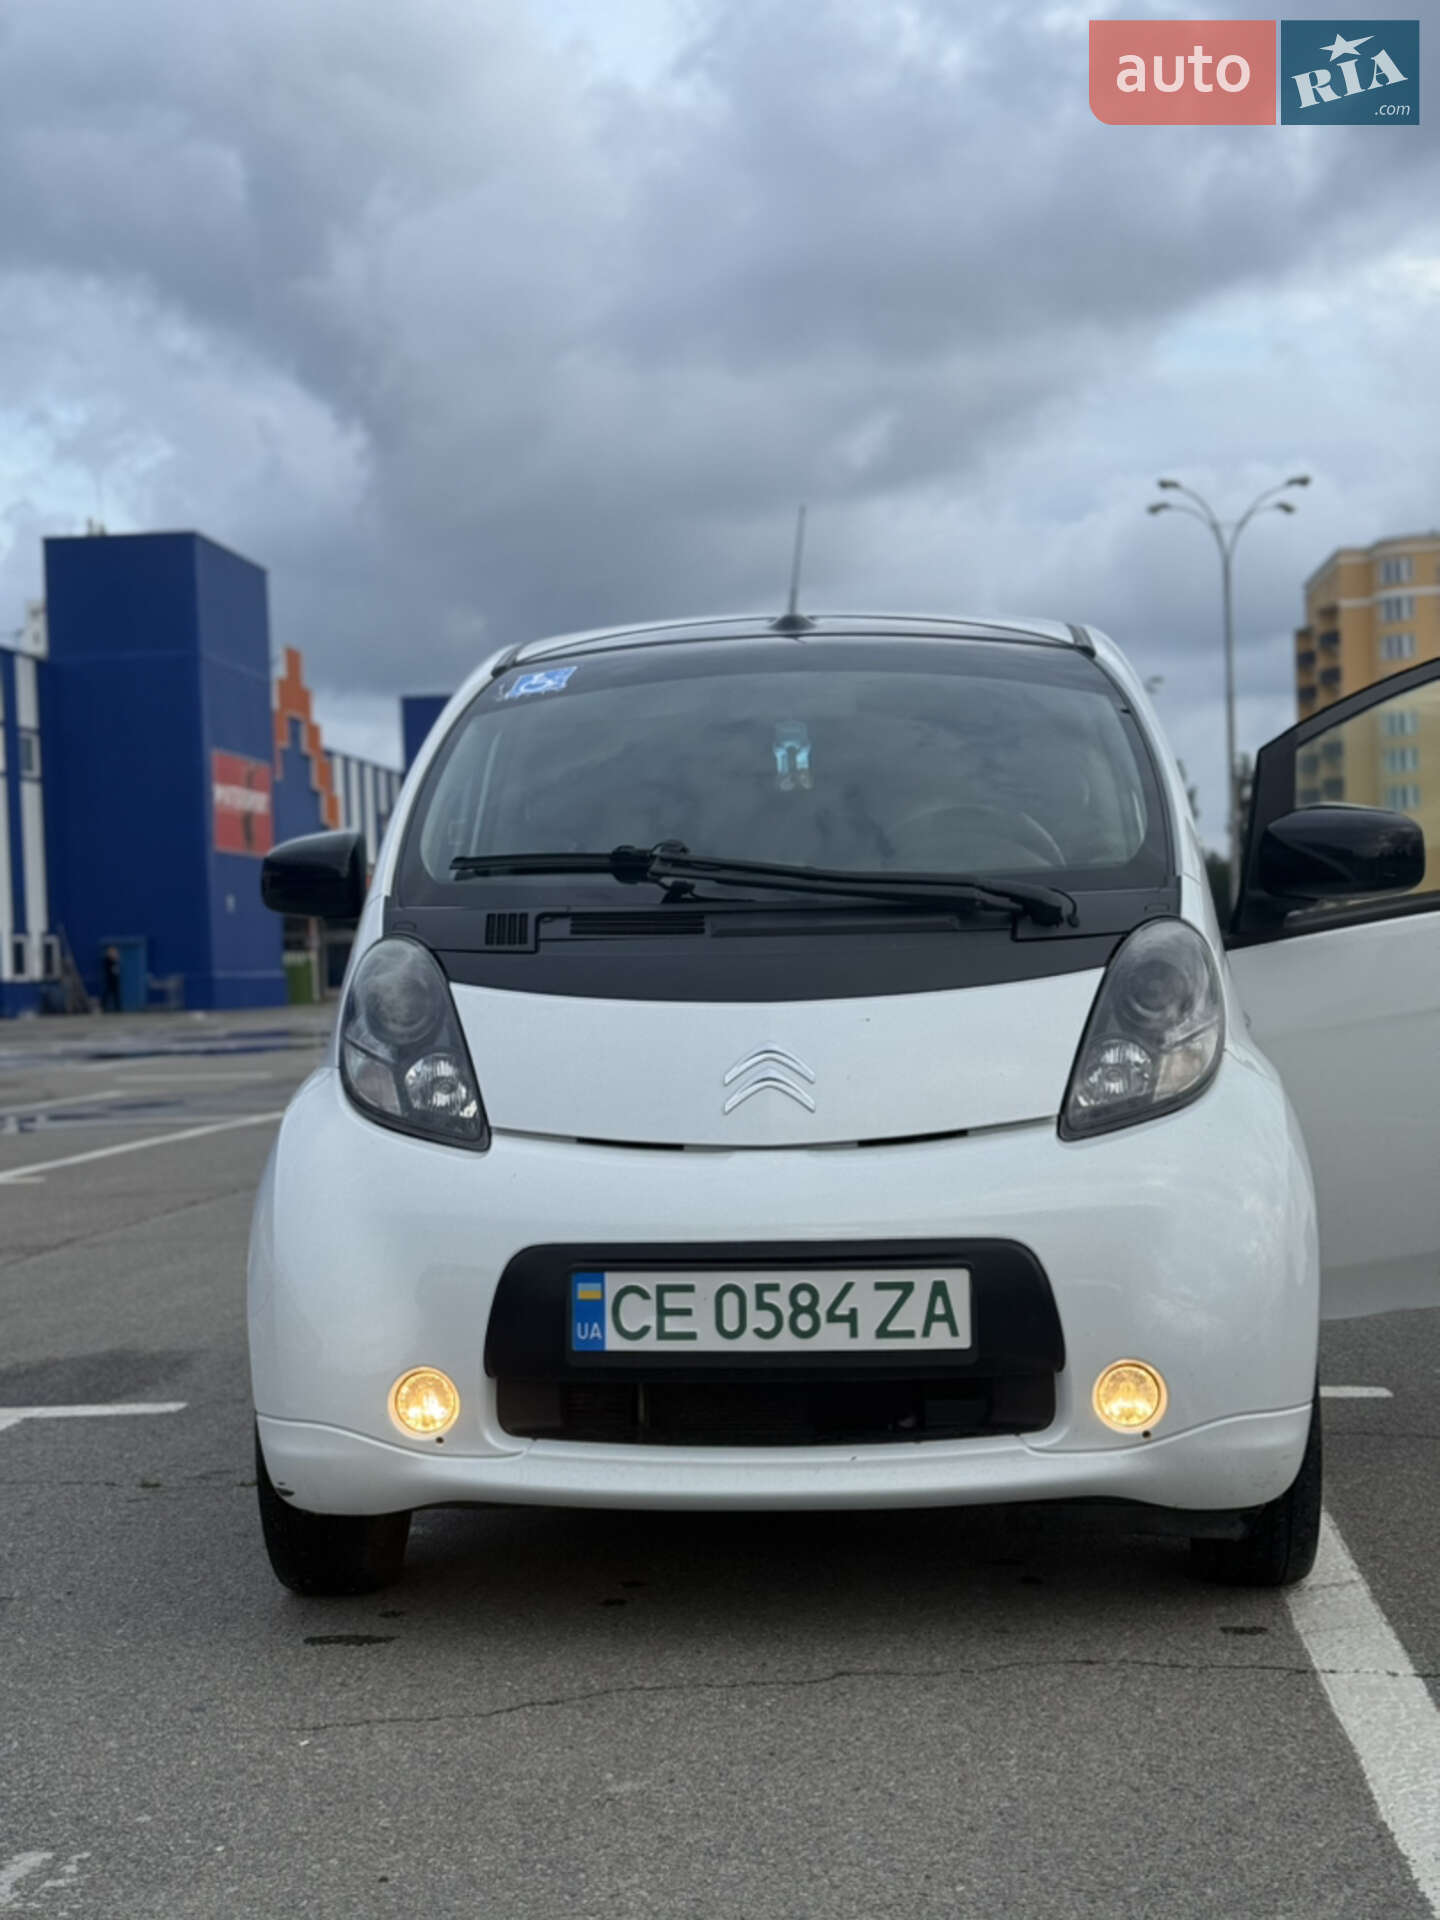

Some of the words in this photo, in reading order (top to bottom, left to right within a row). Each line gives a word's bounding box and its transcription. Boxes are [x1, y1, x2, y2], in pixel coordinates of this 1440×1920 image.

[611, 1283, 698, 1341] CE
[714, 1281, 859, 1340] 0584
[873, 1279, 960, 1339] ZA
[577, 1322, 603, 1340] UA
